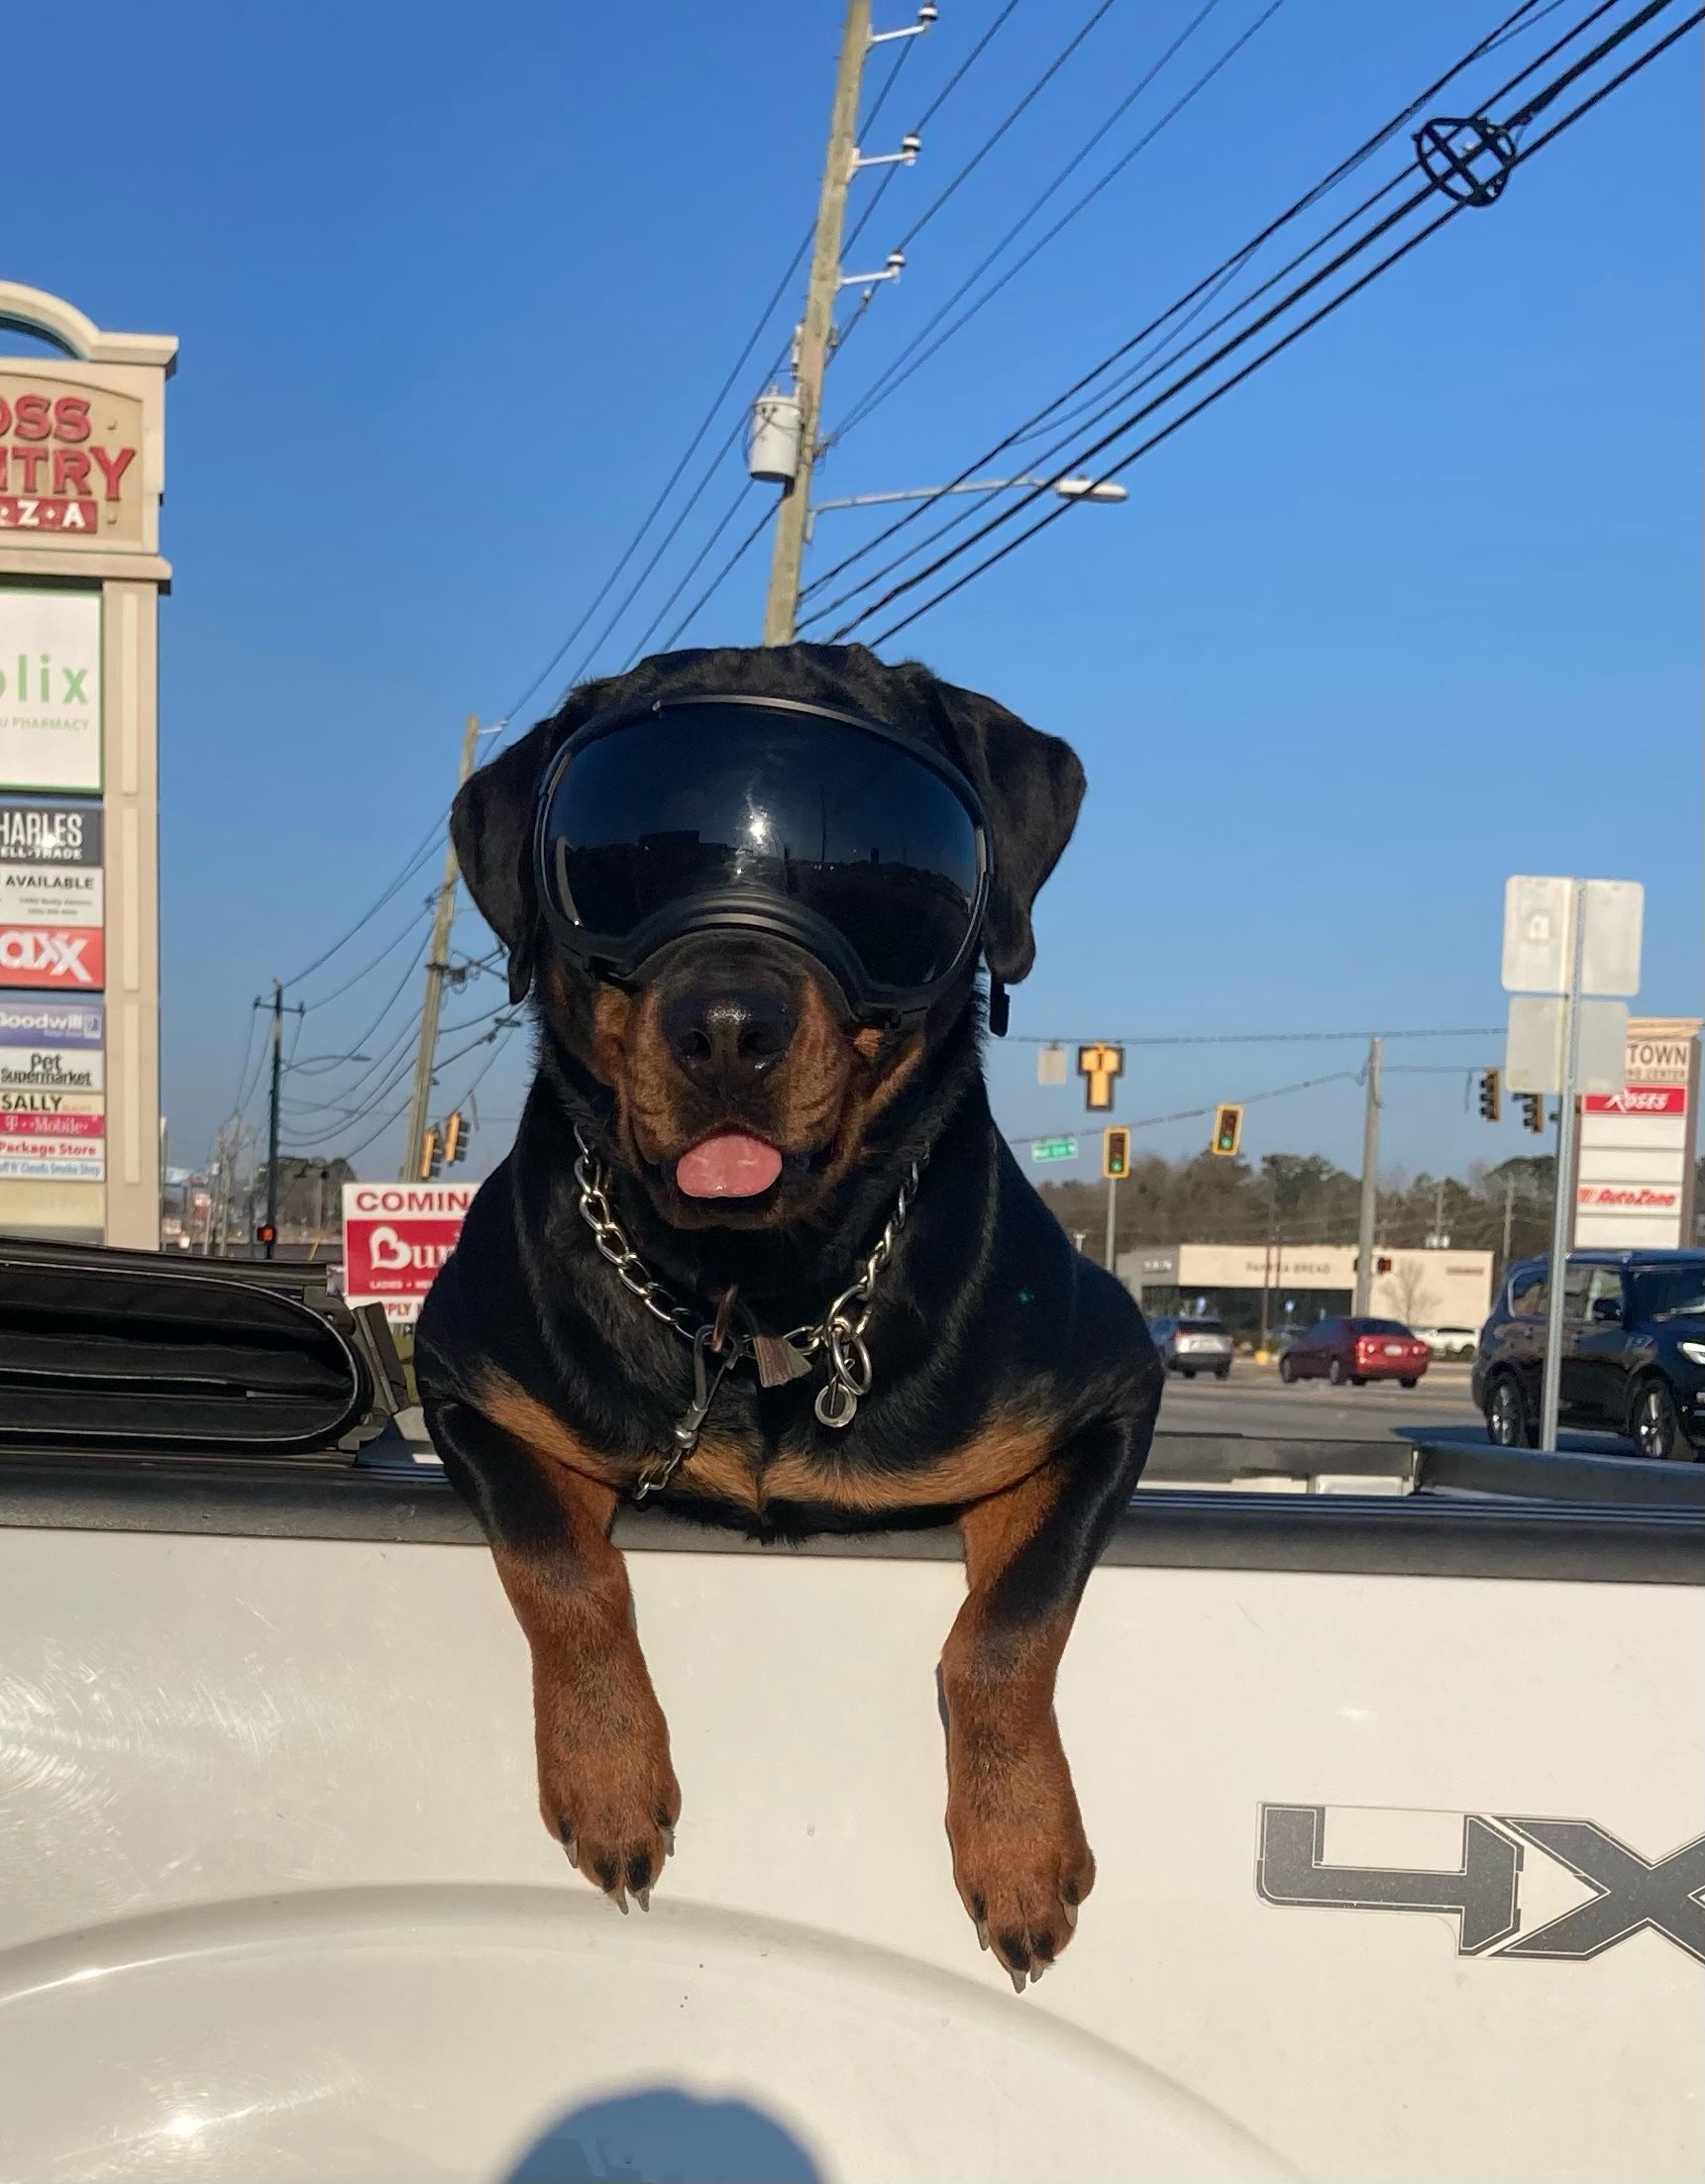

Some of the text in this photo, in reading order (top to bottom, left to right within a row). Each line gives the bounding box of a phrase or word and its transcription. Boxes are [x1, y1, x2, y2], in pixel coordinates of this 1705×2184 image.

[0, 446, 137, 502] TRY
[5, 875, 94, 889] AVAILABLE
[31, 1052, 63, 1072] Pet
[1627, 1044, 1687, 1066] TOWN
[1, 1067, 91, 1087] Supermarket
[1, 1093, 63, 1111] SALLY
[59, 1143, 96, 1156] Store
[1598, 1189, 1675, 1206] AutoZone
